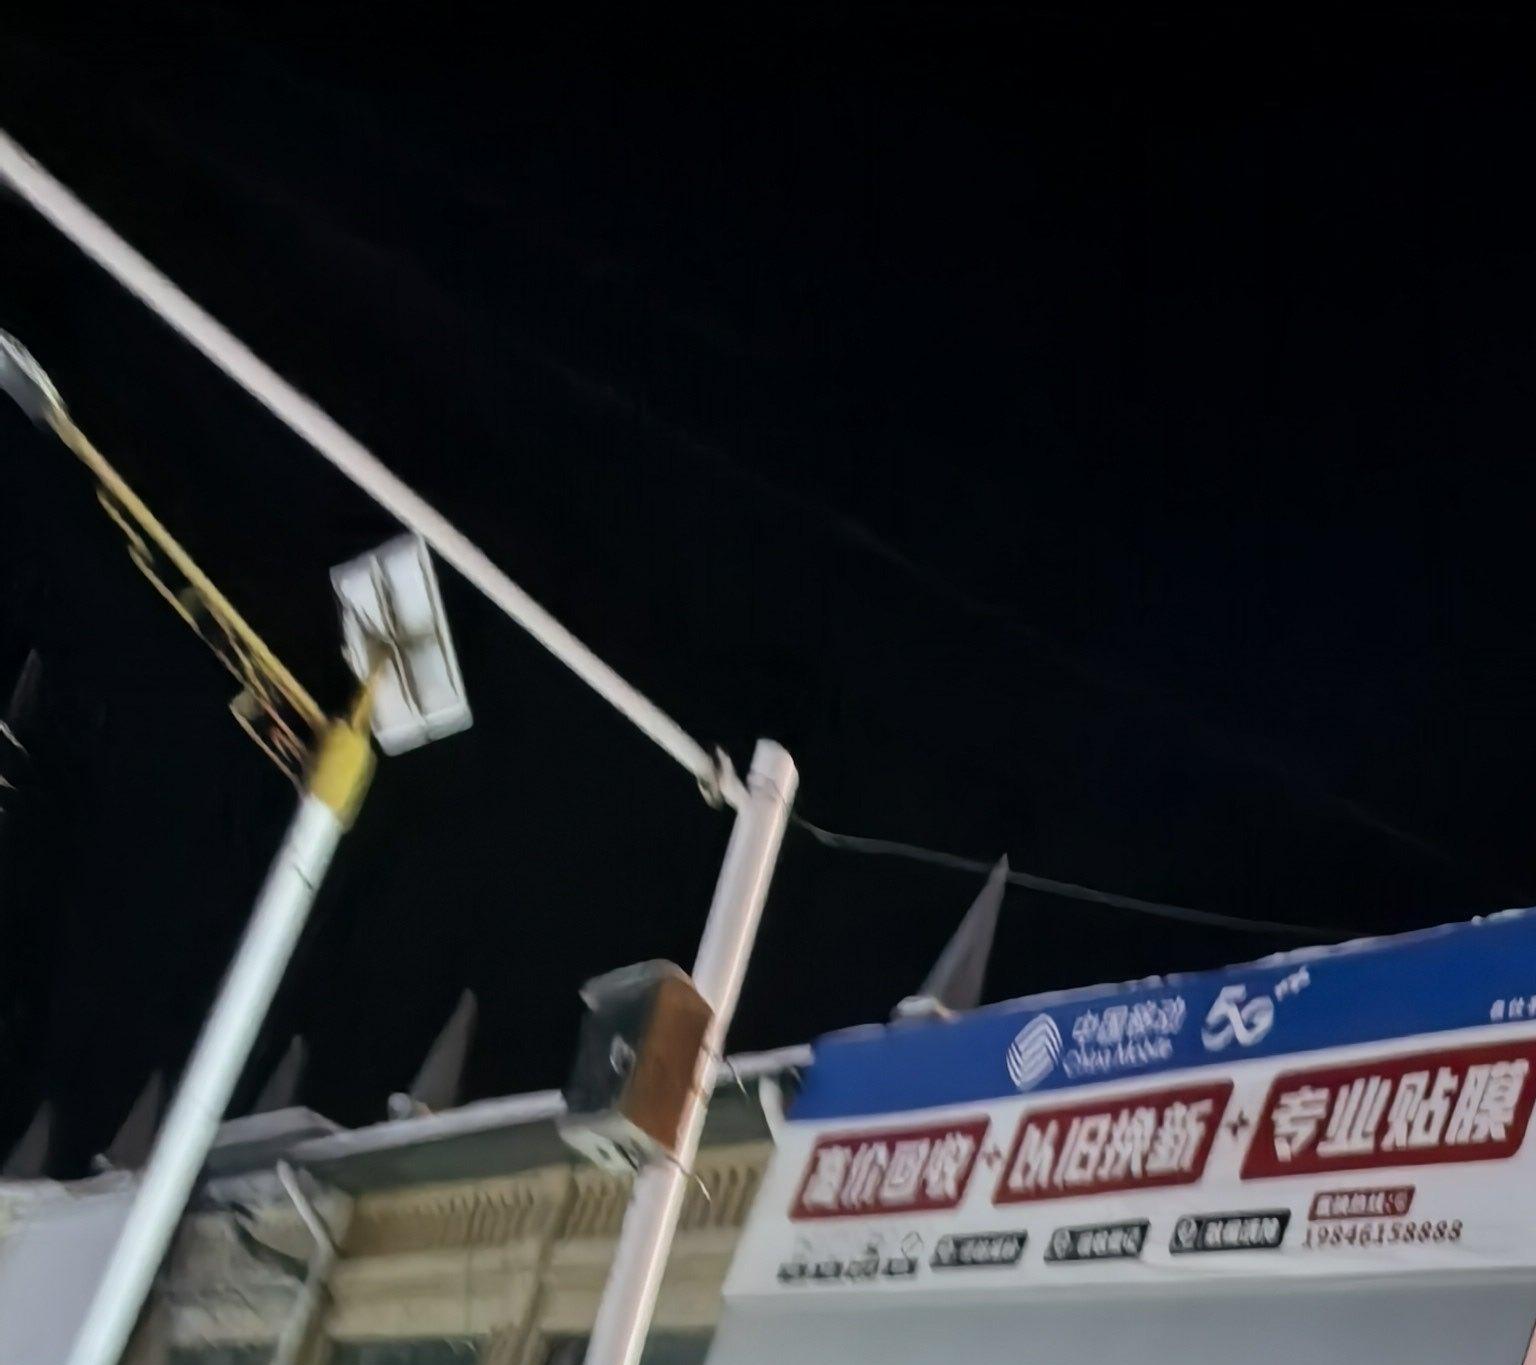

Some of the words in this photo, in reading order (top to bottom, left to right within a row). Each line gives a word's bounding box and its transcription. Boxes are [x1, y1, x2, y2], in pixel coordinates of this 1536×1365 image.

[1008, 1099, 1213, 1190] 以旧换新
[1273, 1058, 1530, 1162] 专业贴膜
